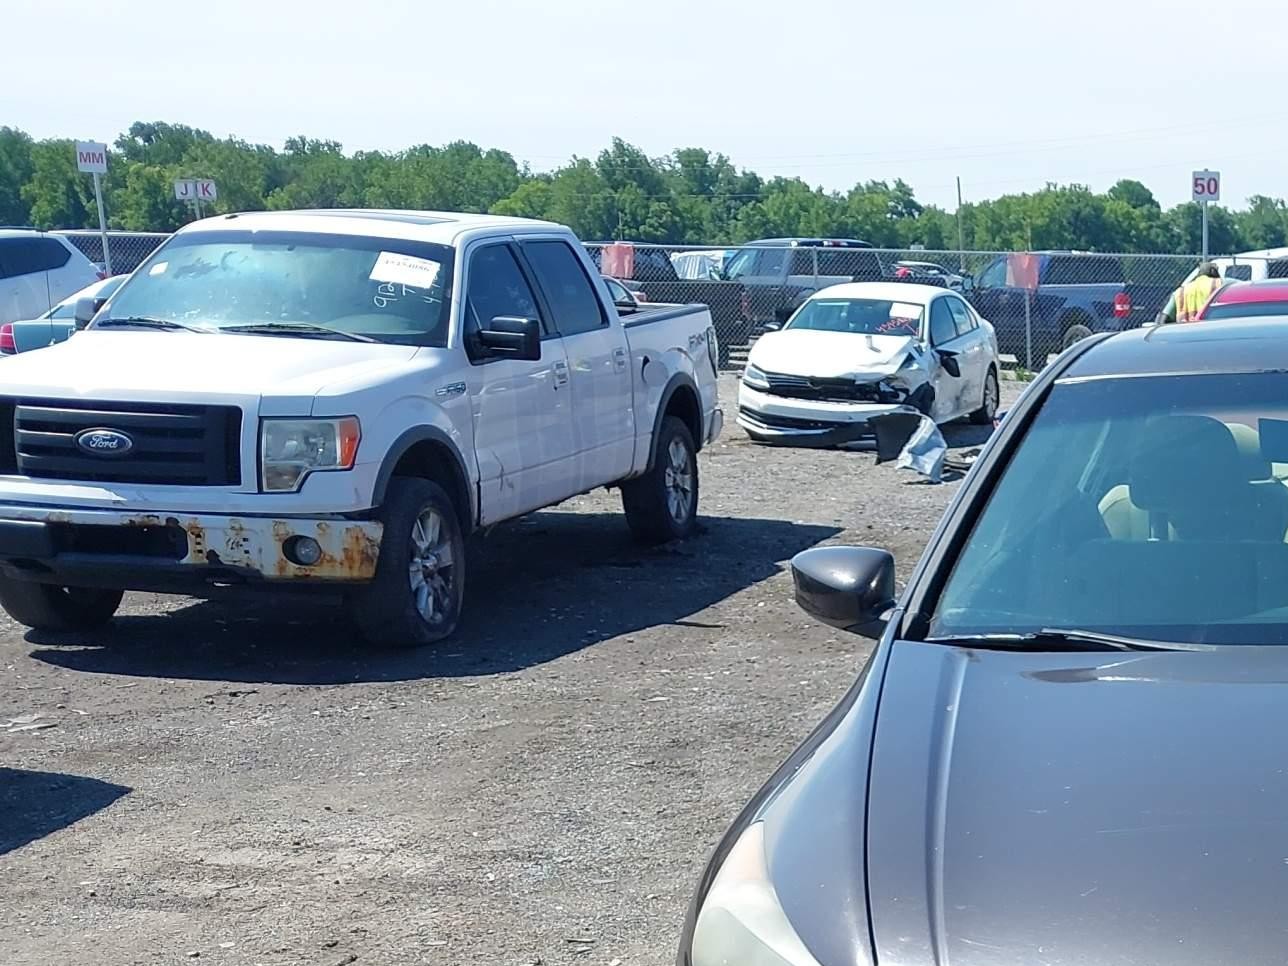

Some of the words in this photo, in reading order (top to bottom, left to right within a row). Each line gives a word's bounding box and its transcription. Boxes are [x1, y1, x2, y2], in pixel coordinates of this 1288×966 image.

[79, 151, 104, 164] MM
[180, 183, 188, 196] J
[202, 183, 212, 196] K
[1194, 177, 1217, 195] 50
[89, 434, 118, 448] Ford
